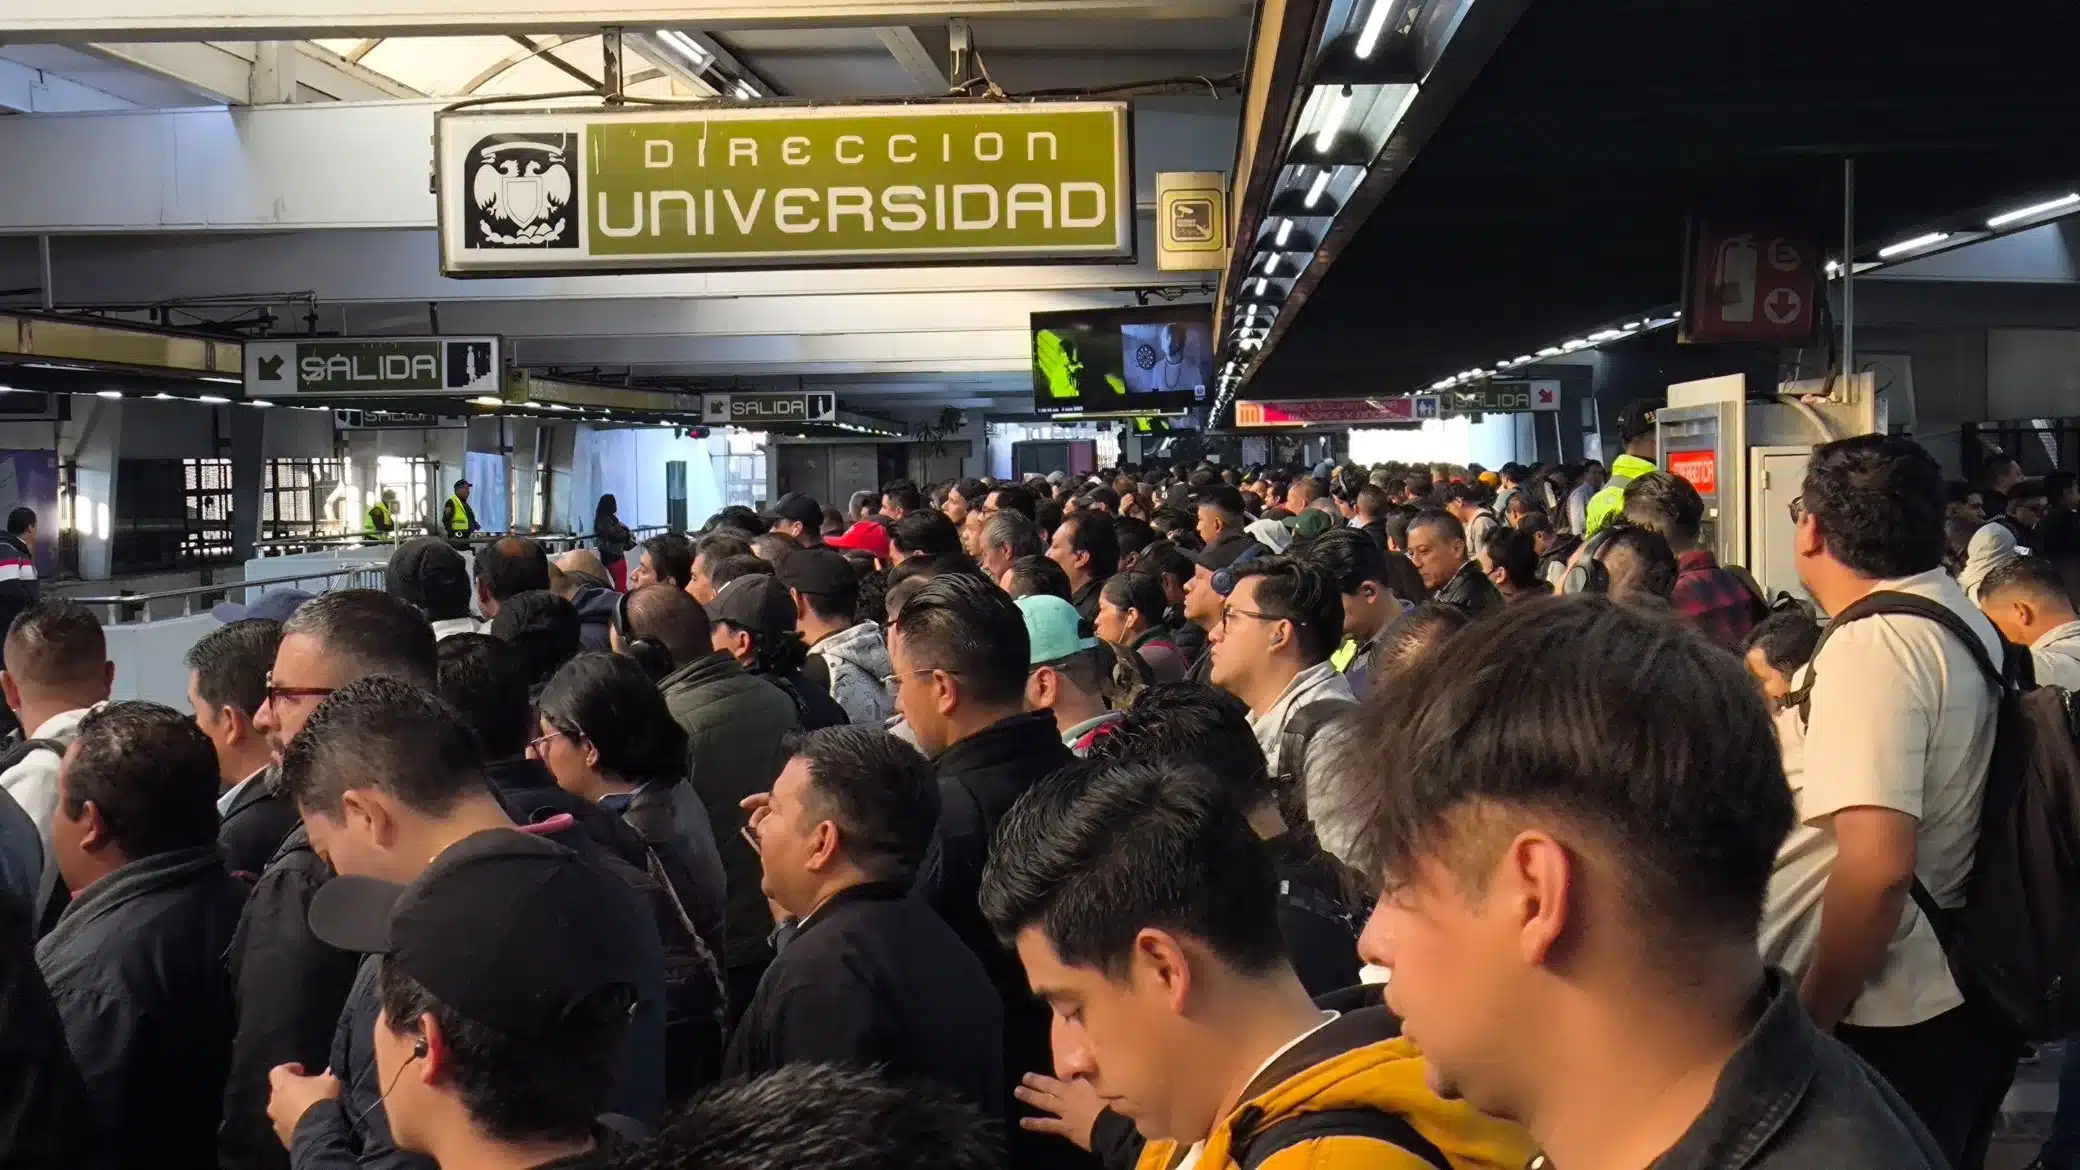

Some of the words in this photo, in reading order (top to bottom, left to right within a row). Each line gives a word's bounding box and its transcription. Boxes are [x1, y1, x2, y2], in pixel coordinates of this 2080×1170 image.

[644, 132, 1058, 168] DIRECCION
[599, 181, 1107, 236] UNIVERSIDAD
[301, 354, 436, 381] SALIDA
[732, 400, 804, 415] SALIDA
[1455, 392, 1529, 407] SALIDA
